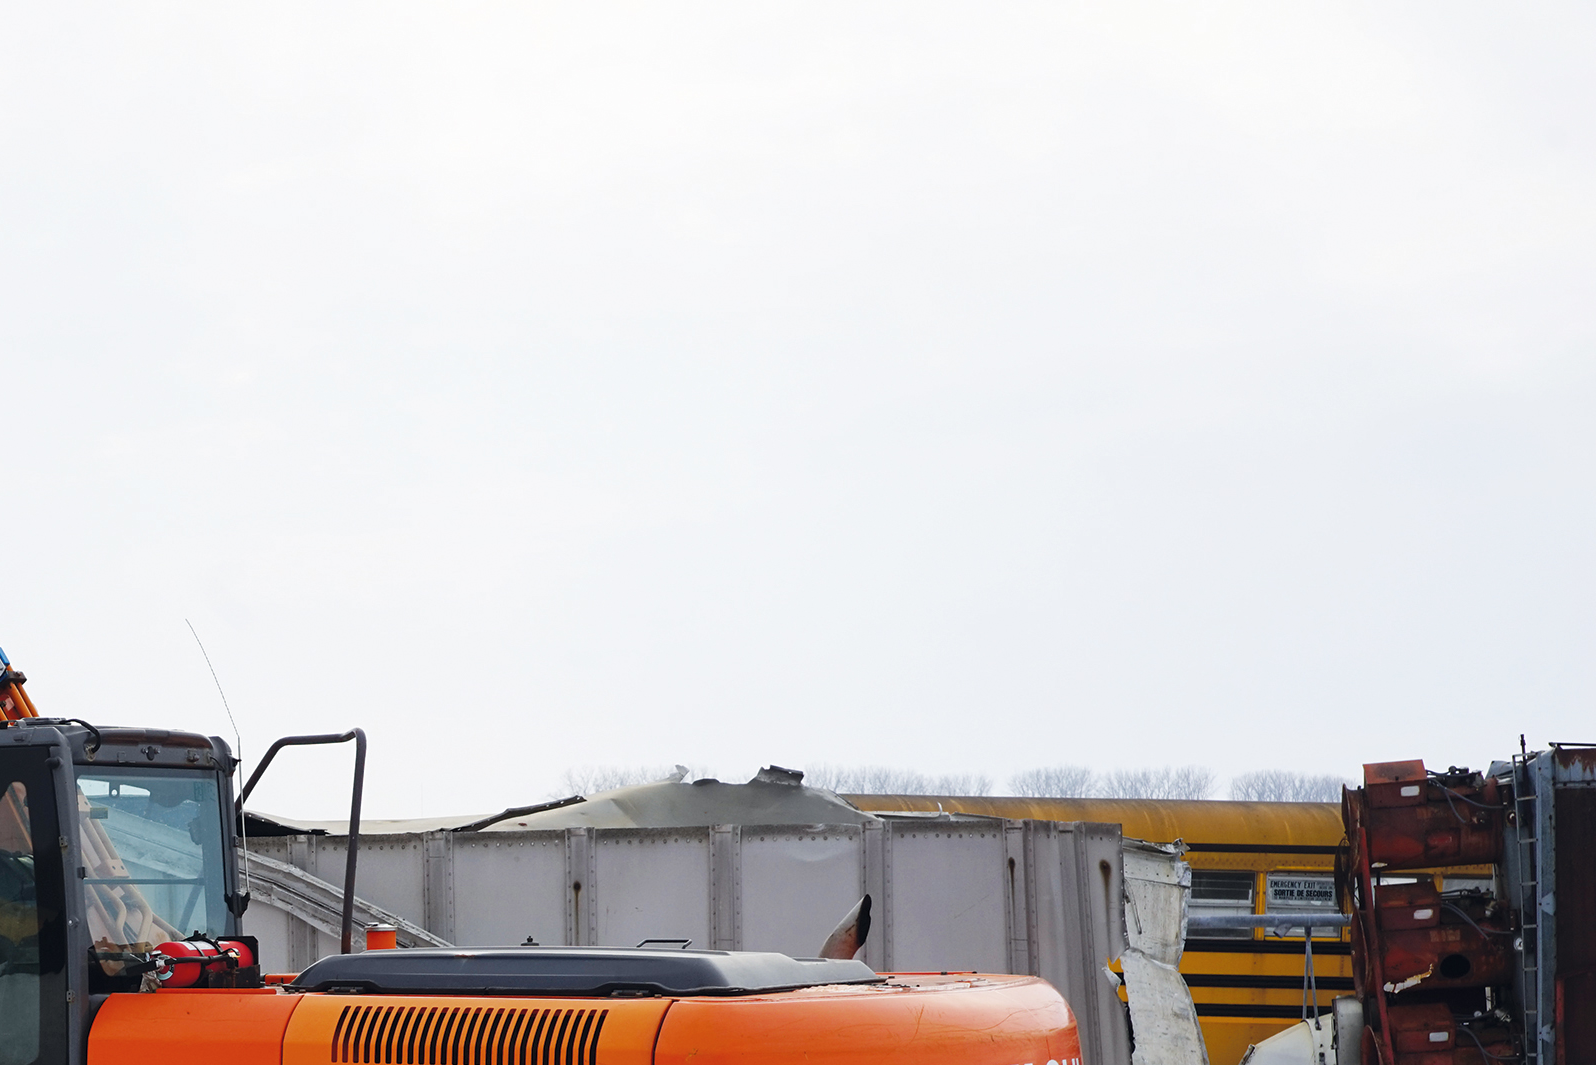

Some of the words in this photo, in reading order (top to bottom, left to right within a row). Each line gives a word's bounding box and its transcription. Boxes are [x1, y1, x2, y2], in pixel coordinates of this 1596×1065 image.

[1270, 880, 1302, 888] EMERGENCY
[1304, 881, 1316, 890] EXIT
[1273, 889, 1295, 897] SORTIE
[1305, 890, 1333, 898] SECOURS
